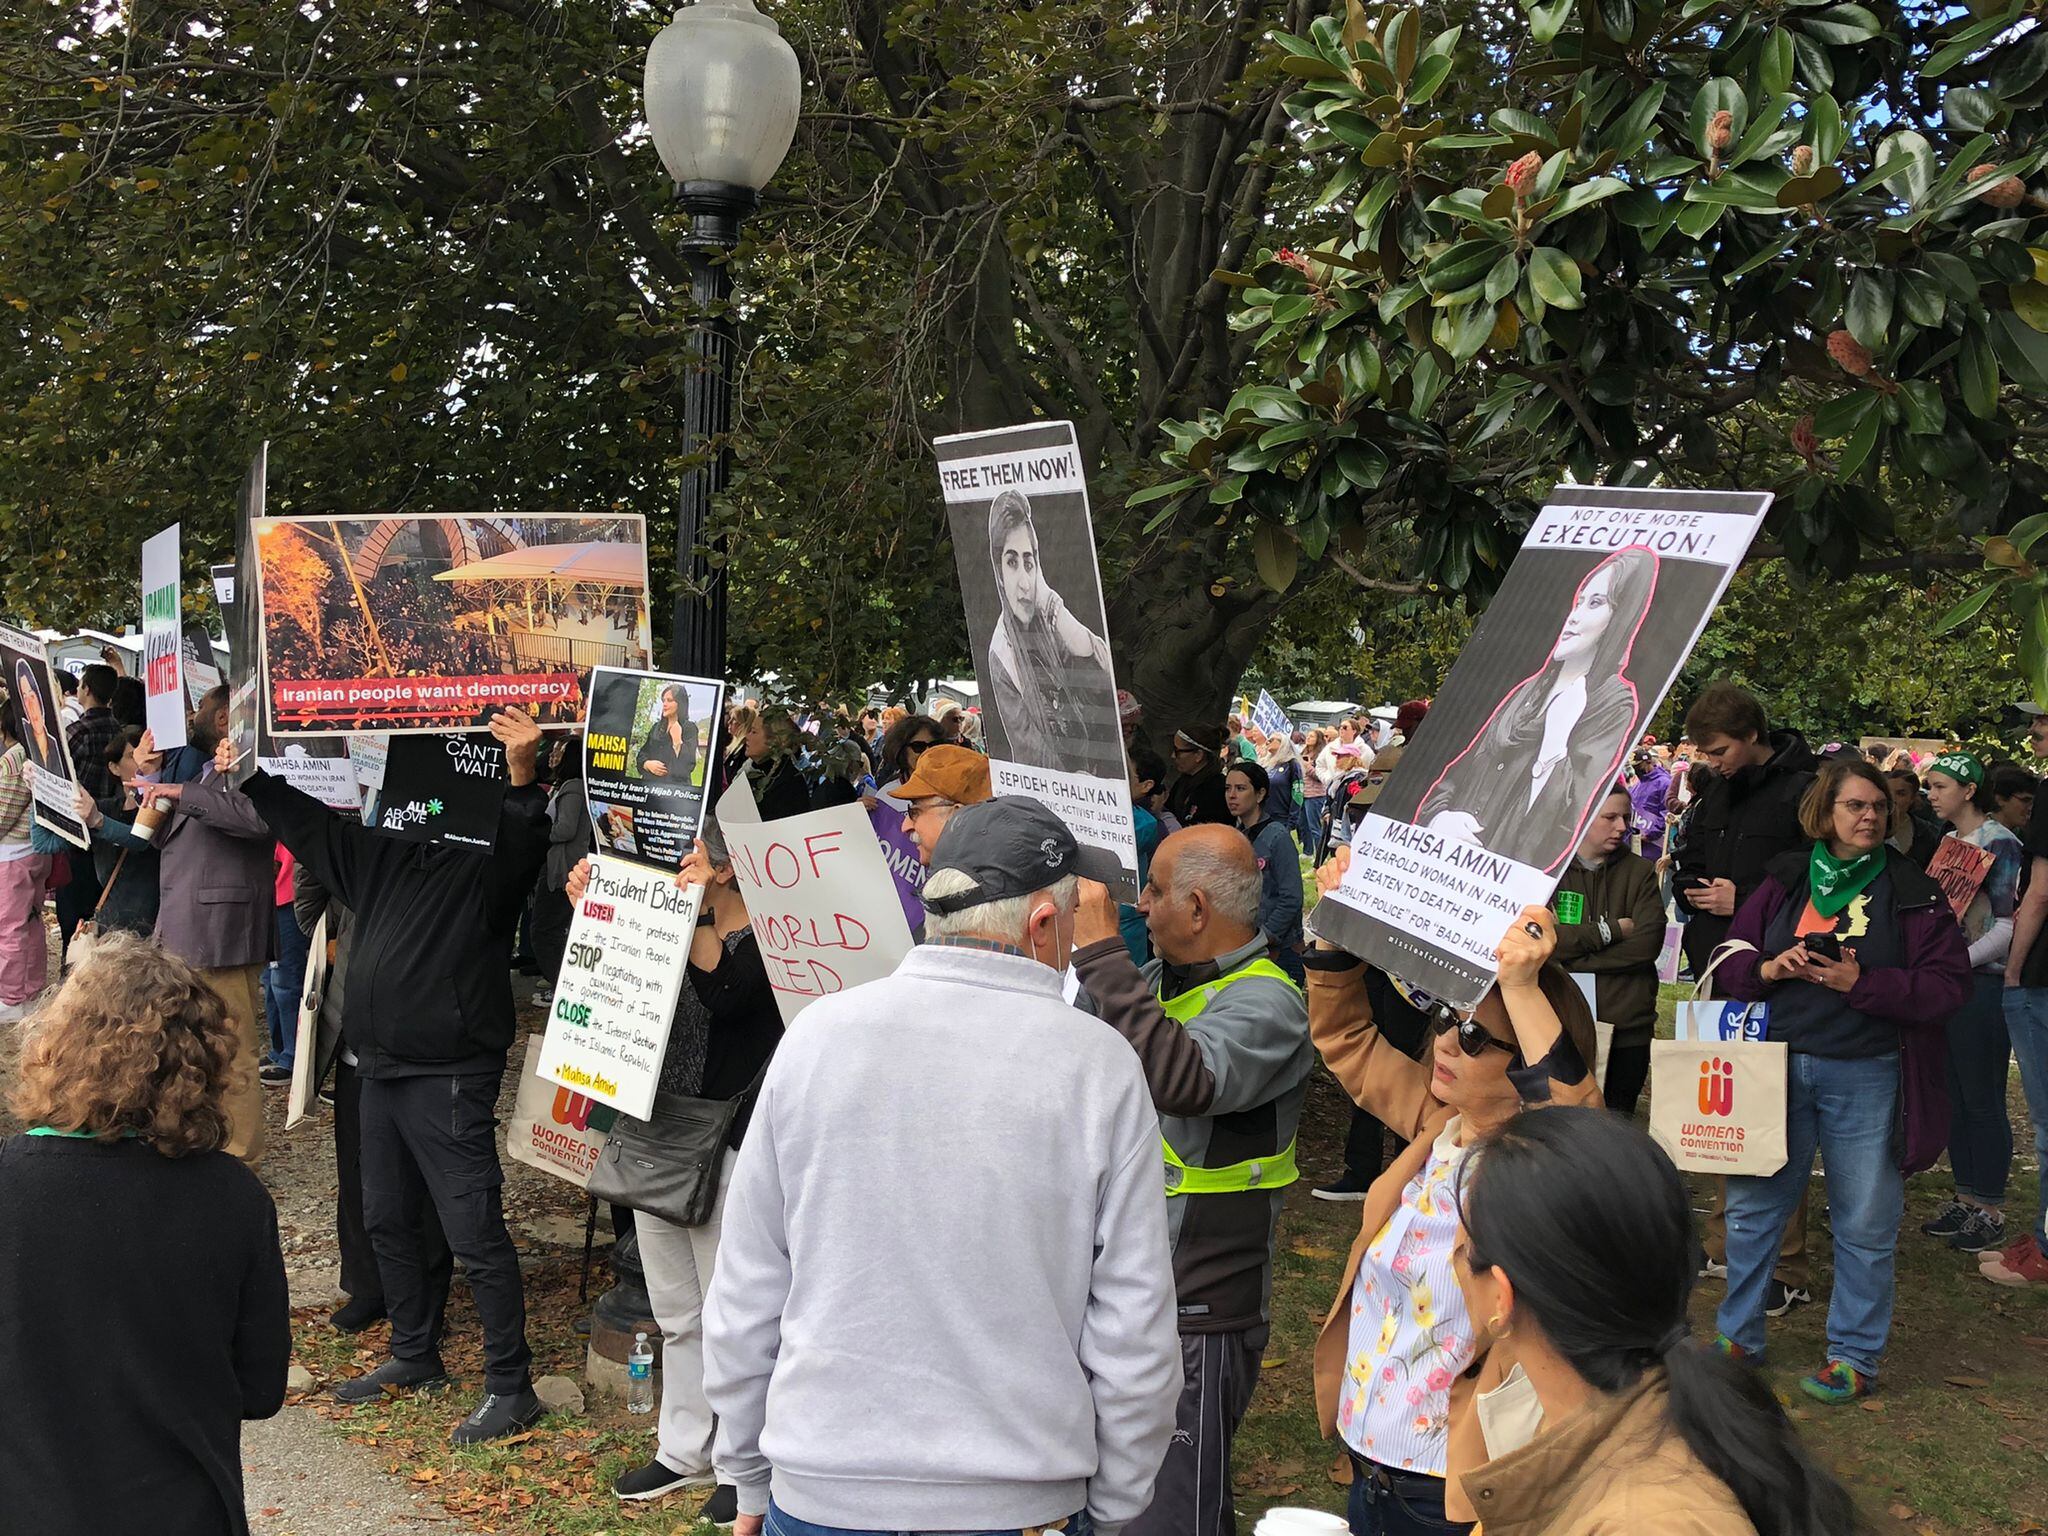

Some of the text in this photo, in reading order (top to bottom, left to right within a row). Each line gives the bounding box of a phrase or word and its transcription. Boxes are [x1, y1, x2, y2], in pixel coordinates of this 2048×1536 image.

[942, 452, 1076, 490] FREE THEM NOW!
[1570, 510, 1703, 528] NOT ONE MORE
[1539, 524, 1716, 556] EXECUTION!
[147, 652, 178, 697] MATTER
[282, 682, 570, 704] Iranian people want democracy
[446, 740, 502, 763] CAN'T
[588, 733, 626, 752] MAHSA
[268, 759, 332, 771] MAHSA AMINI
[454, 757, 502, 780] WAIT.
[592, 752, 624, 770] AMINI
[588, 778, 618, 790] Murdered
[619, 782, 628, 792] by
[628, 784, 649, 794] Iran's
[650, 786, 672, 796] Hijab
[589, 788, 610, 797] Justice
[611, 792, 621, 800] for
[1000, 770, 1118, 807] SEPIDEH GHALIYAN
[384, 807, 426, 824] ABOVE
[406, 800, 428, 816] ALL
[1062, 805, 1094, 820] ACTIVIST
[1098, 812, 1128, 826] JAILED
[382, 818, 404, 830] ALL
[1070, 823, 1134, 844] TAPPEH STRIKE
[878, 838, 927, 887] OMEN
[1382, 822, 1512, 884] MAHSA AMINI
[1940, 840, 1988, 875] BODILY
[1358, 841, 1522, 916] 22 YEAR-OLD WOMAN IN IRAN
[586, 864, 692, 923] President Biden,
[1362, 868, 1484, 926] BEATEN TO DEATH BY
[584, 900, 679, 945] LISTEN to the protests
[1372, 896, 1411, 921] POLICE"
[1410, 914, 1432, 932] FOR
[1434, 924, 1464, 945] "BAD
[594, 932, 607, 946] the
[610, 936, 640, 958] Iranian
[568, 942, 662, 994] STOP negotiating with
[562, 976, 574, 992] the
[580, 986, 624, 1010] government
[626, 1000, 636, 1014] of
[556, 998, 592, 1028] CLOSE
[592, 1018, 602, 1031] the
[632, 1029, 658, 1052] Section
[562, 1029, 573, 1041] of
[574, 1034, 586, 1048] the
[588, 1036, 616, 1058] Islamic
[562, 1064, 617, 1095] Mahsa Amini
[532, 1124, 600, 1160] WOMEN'S
[1680, 1138, 1744, 1152] CONVENTION
[1682, 1124, 1745, 1140] WOMEN'S
